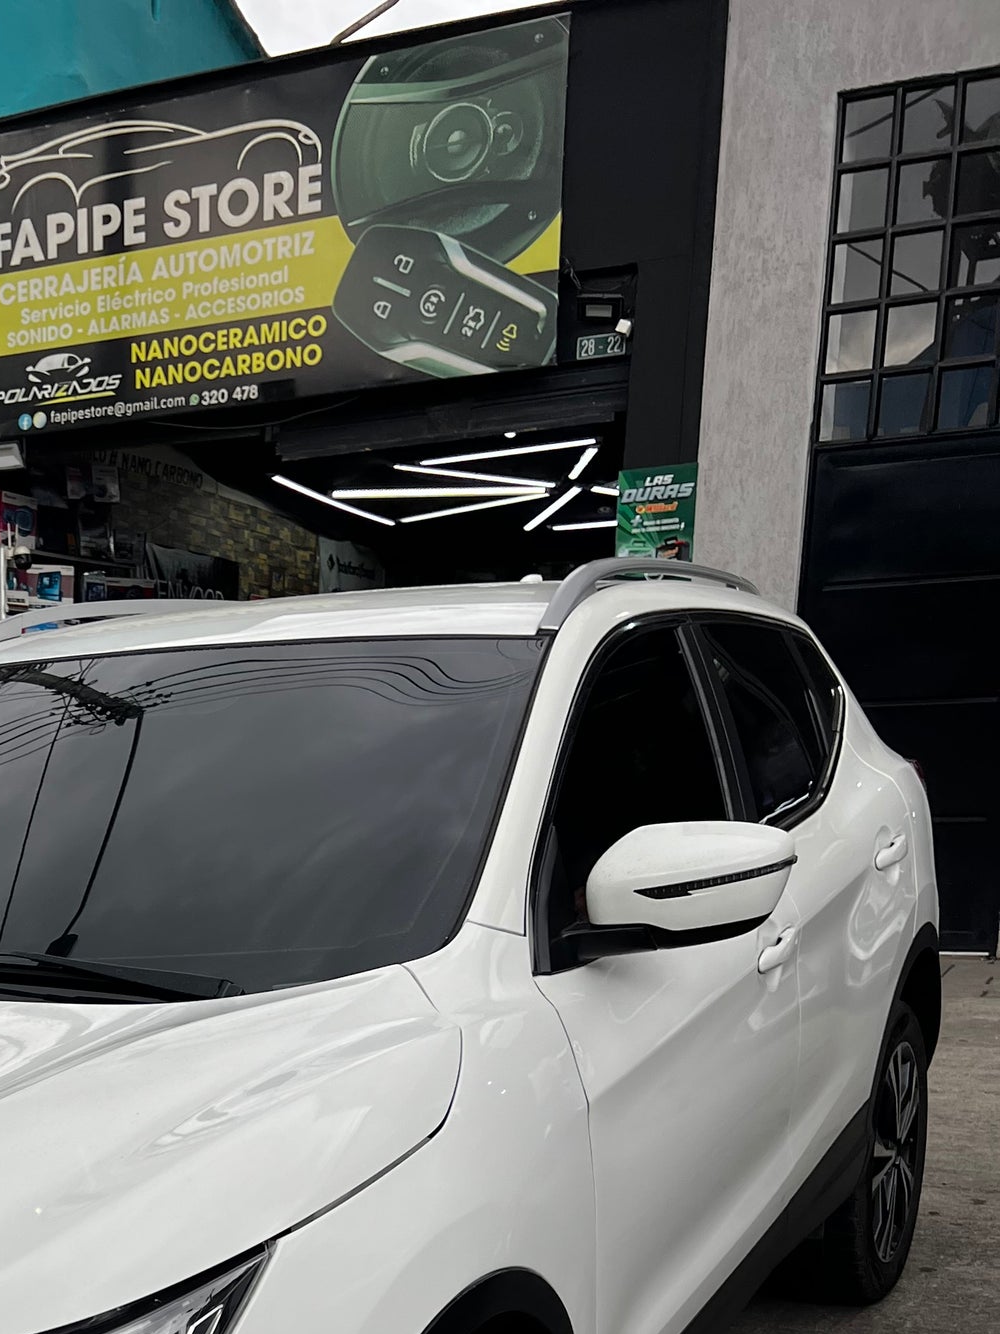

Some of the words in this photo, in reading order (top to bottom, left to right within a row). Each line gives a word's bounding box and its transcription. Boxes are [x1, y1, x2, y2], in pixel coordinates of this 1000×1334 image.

[163, 163, 322, 238] STORE
[151, 230, 315, 281] AUTOMOTRIZ
[7, 323, 73, 348] SONIDO
[87, 307, 170, 336] ALARMAS
[184, 286, 306, 321] ACCESORIOS
[20, 299, 91, 325] Servicio
[97, 287, 177, 313] Eléctrico
[182, 265, 289, 300] Profesional
[130, 314, 327, 364] NANOCERAMICO
[135, 343, 323, 390] NANOCARBONO
[50, 395, 186, 425] fapipestore@gmail.com
[201, 388, 228, 406] 320
[232, 384, 259, 402] 478
[620, 482, 695, 503] DURAS
[644, 474, 674, 487] LAS
